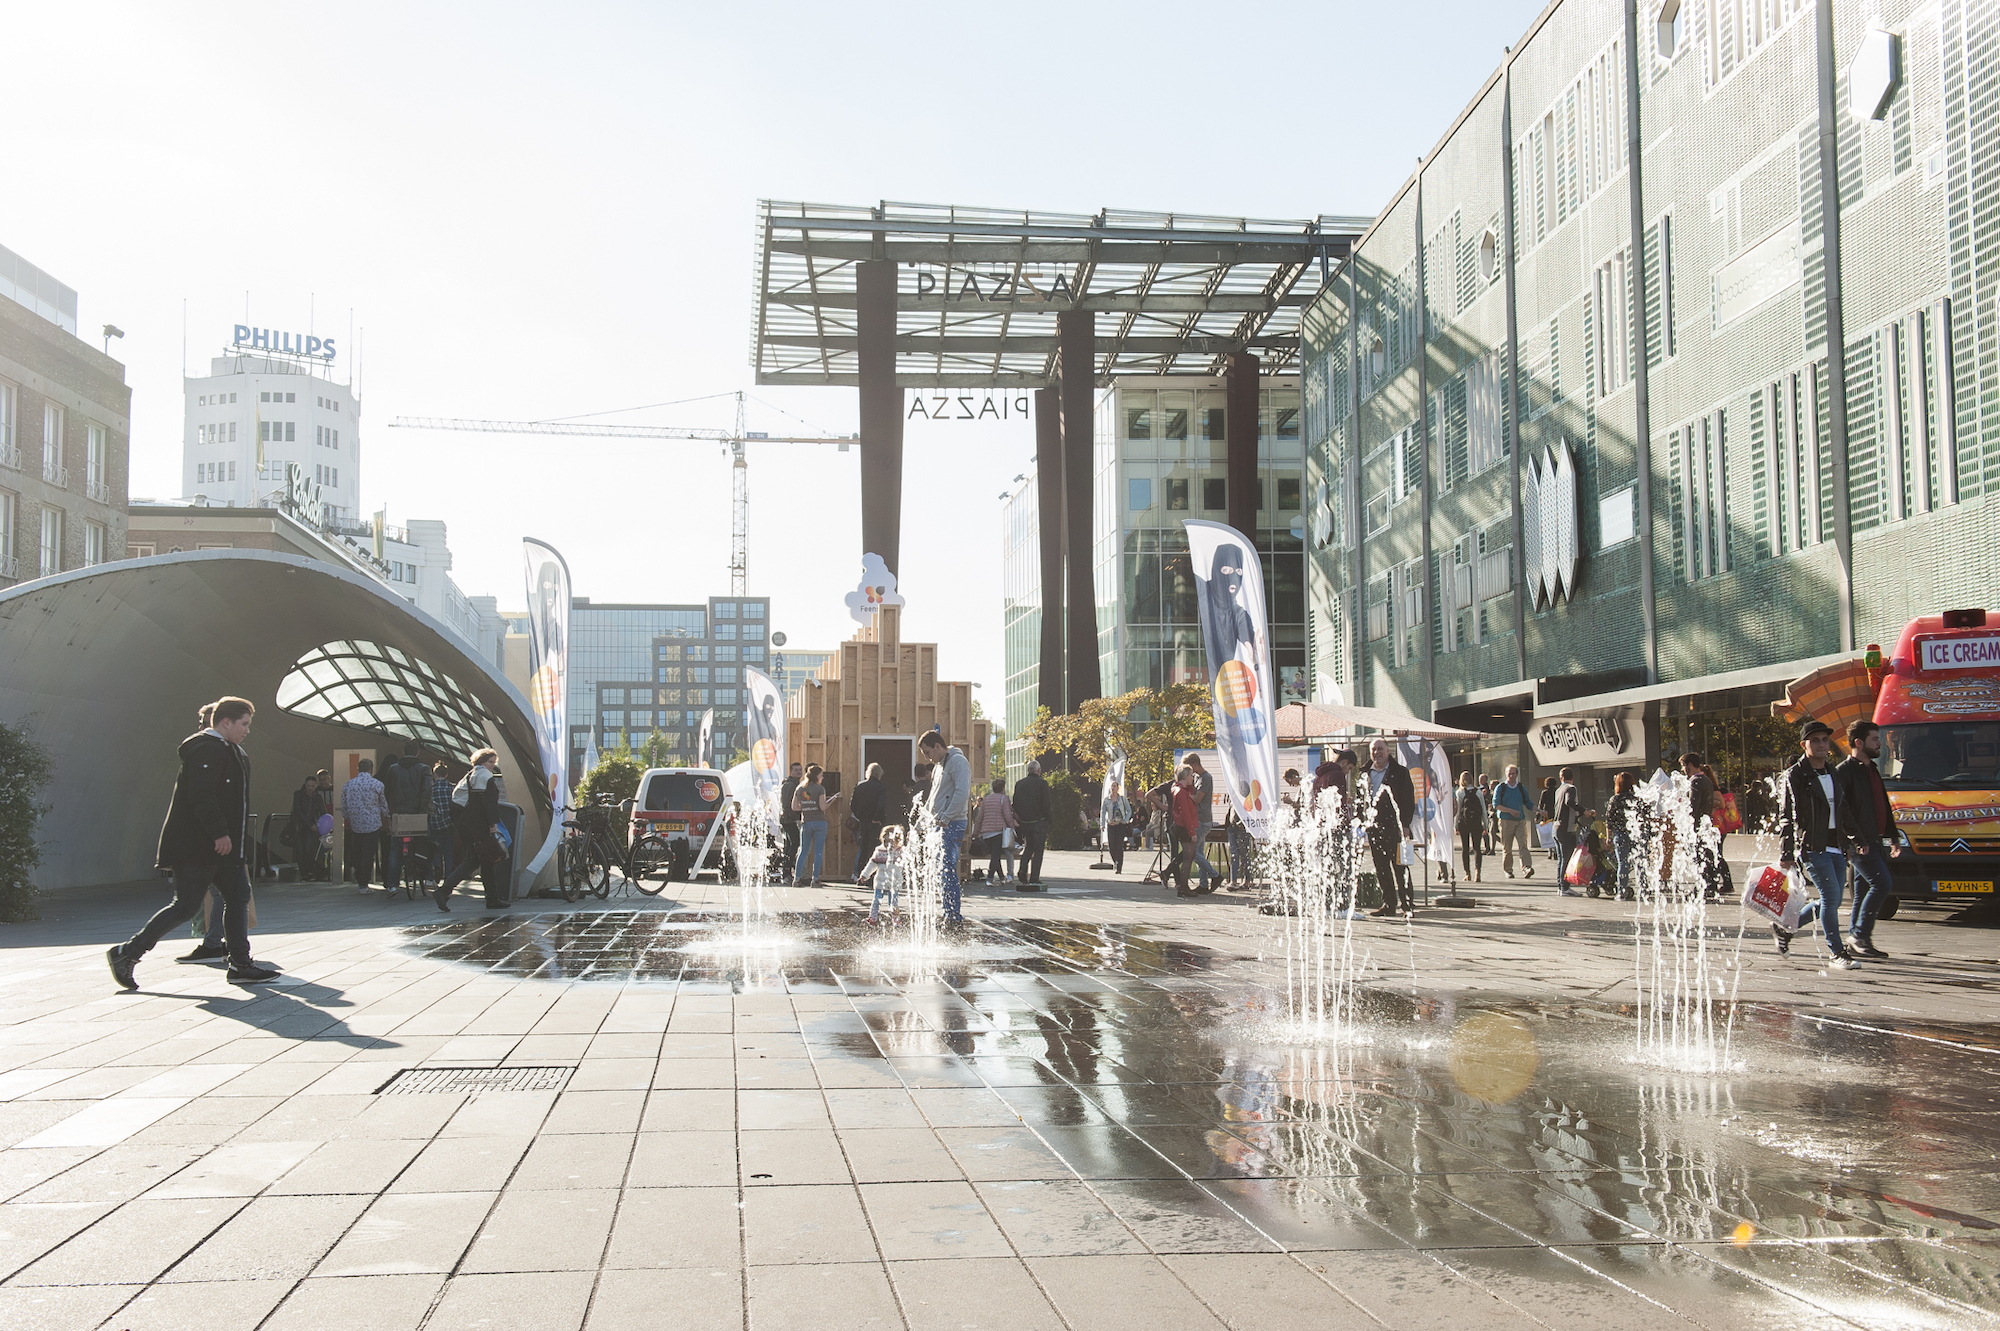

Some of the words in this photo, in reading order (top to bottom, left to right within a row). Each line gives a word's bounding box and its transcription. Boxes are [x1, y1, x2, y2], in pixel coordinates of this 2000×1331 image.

[918, 273, 1074, 303] PIAZZA
[234, 324, 336, 359] PHILIPS
[1929, 644, 1949, 664] ICE
[1953, 641, 2000, 662] CREAM
[1898, 812, 1918, 821] LA
[1923, 809, 1974, 821] DOLCE
[1939, 882, 1990, 891] 54-VHN-5
